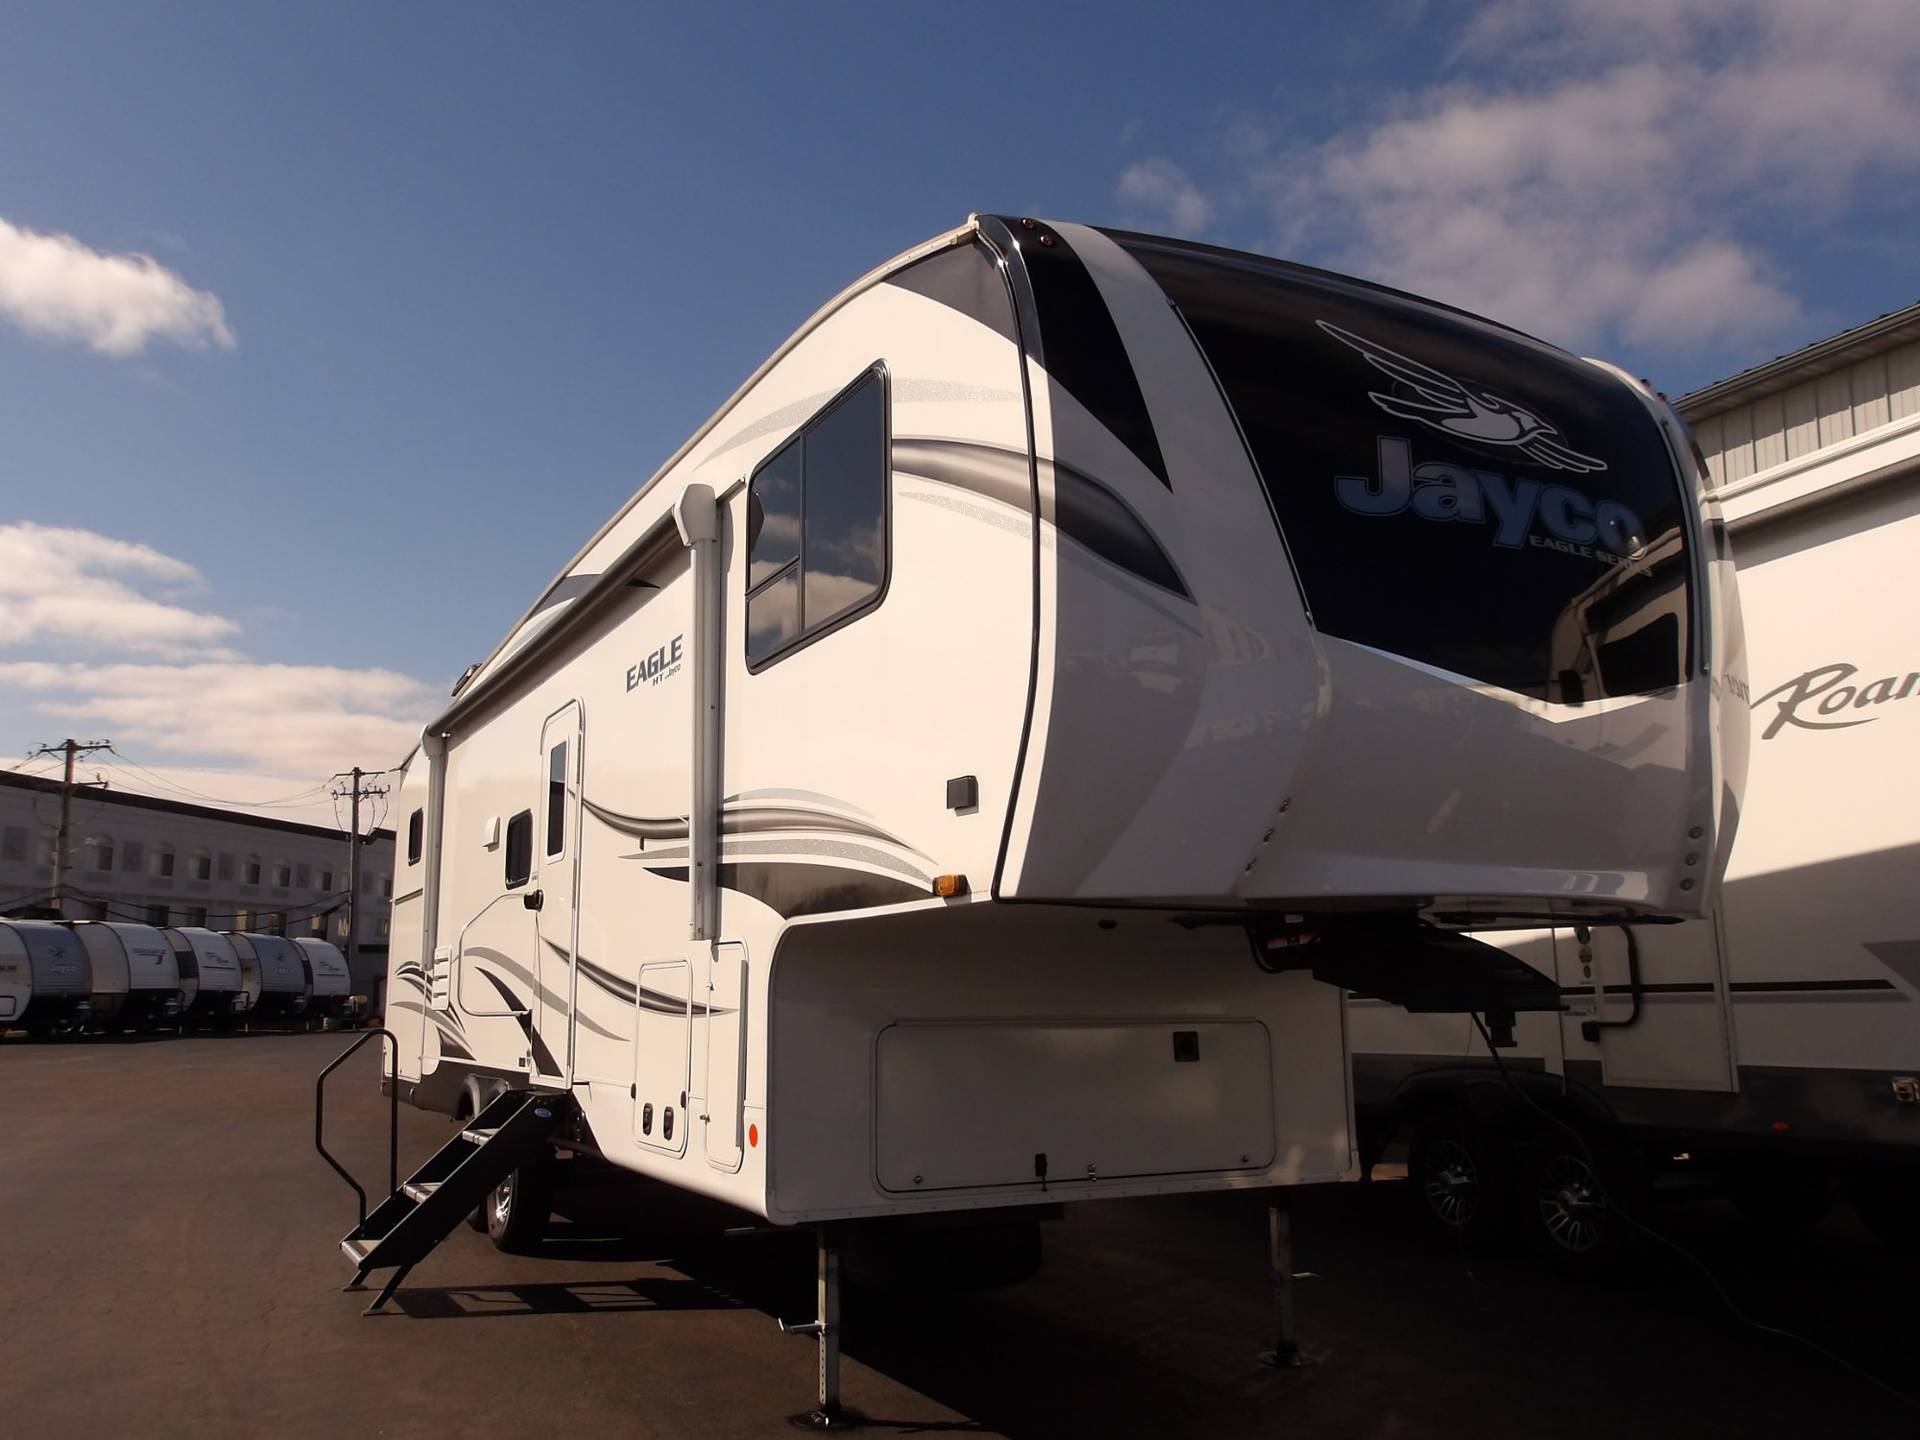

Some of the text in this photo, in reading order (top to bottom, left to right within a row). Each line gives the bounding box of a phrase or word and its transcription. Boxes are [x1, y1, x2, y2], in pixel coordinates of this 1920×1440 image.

[1334, 435, 1647, 560] Jayco
[1529, 535, 1654, 578] EAGLE SERIS
[626, 633, 683, 693] EAGLE
[652, 672, 664, 687] HT
